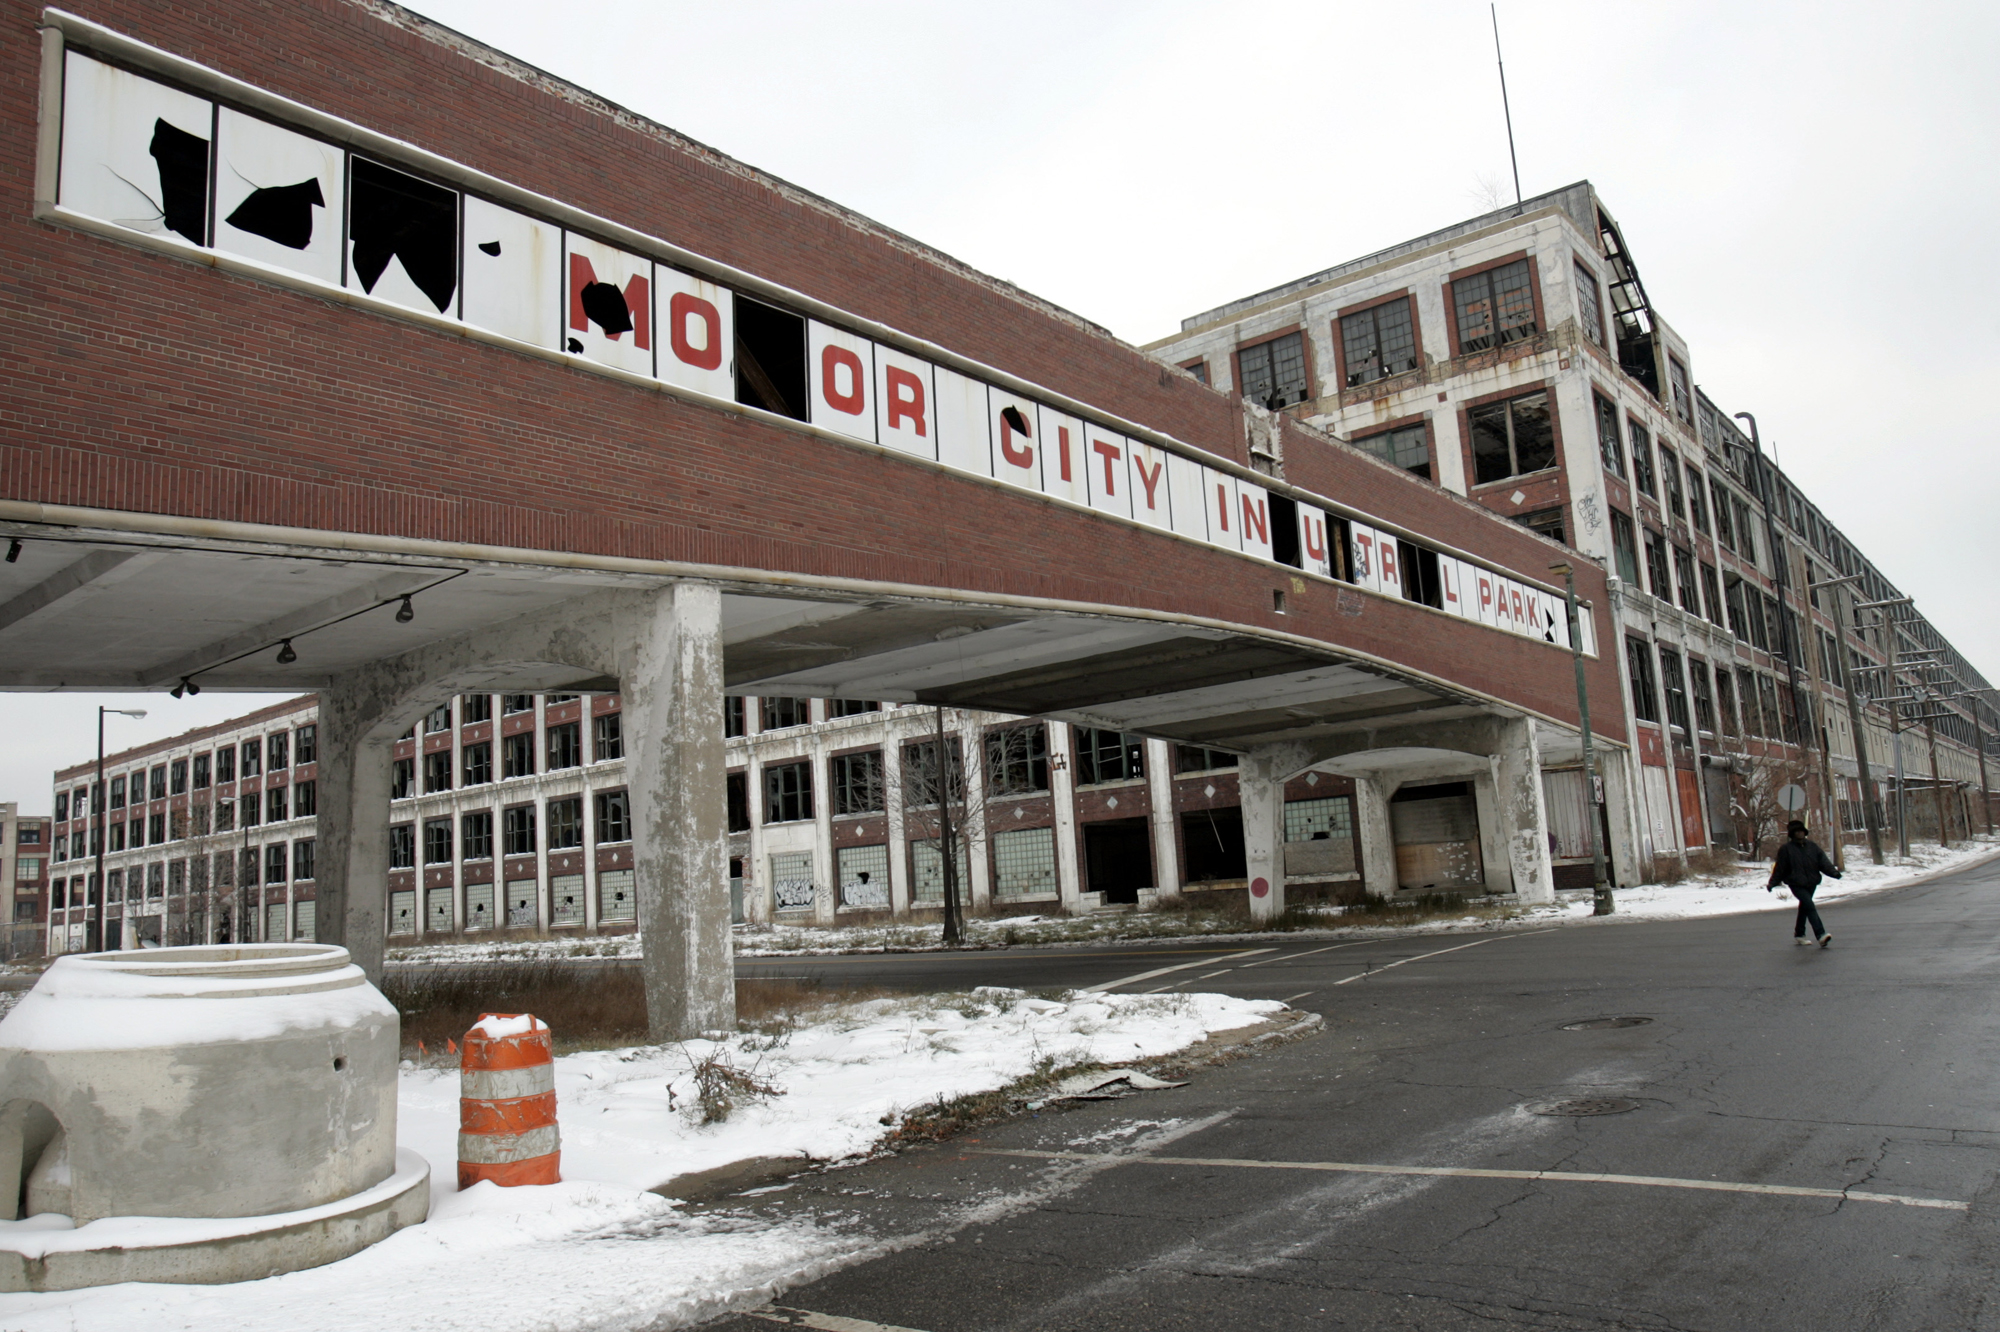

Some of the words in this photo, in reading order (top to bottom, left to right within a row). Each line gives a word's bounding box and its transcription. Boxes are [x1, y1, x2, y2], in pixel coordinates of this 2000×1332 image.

[570, 252, 927, 438] MOOR
[1000, 405, 1162, 510] CITY
[1217, 483, 1457, 603] INUTRL
[1479, 576, 1541, 629] PARK
